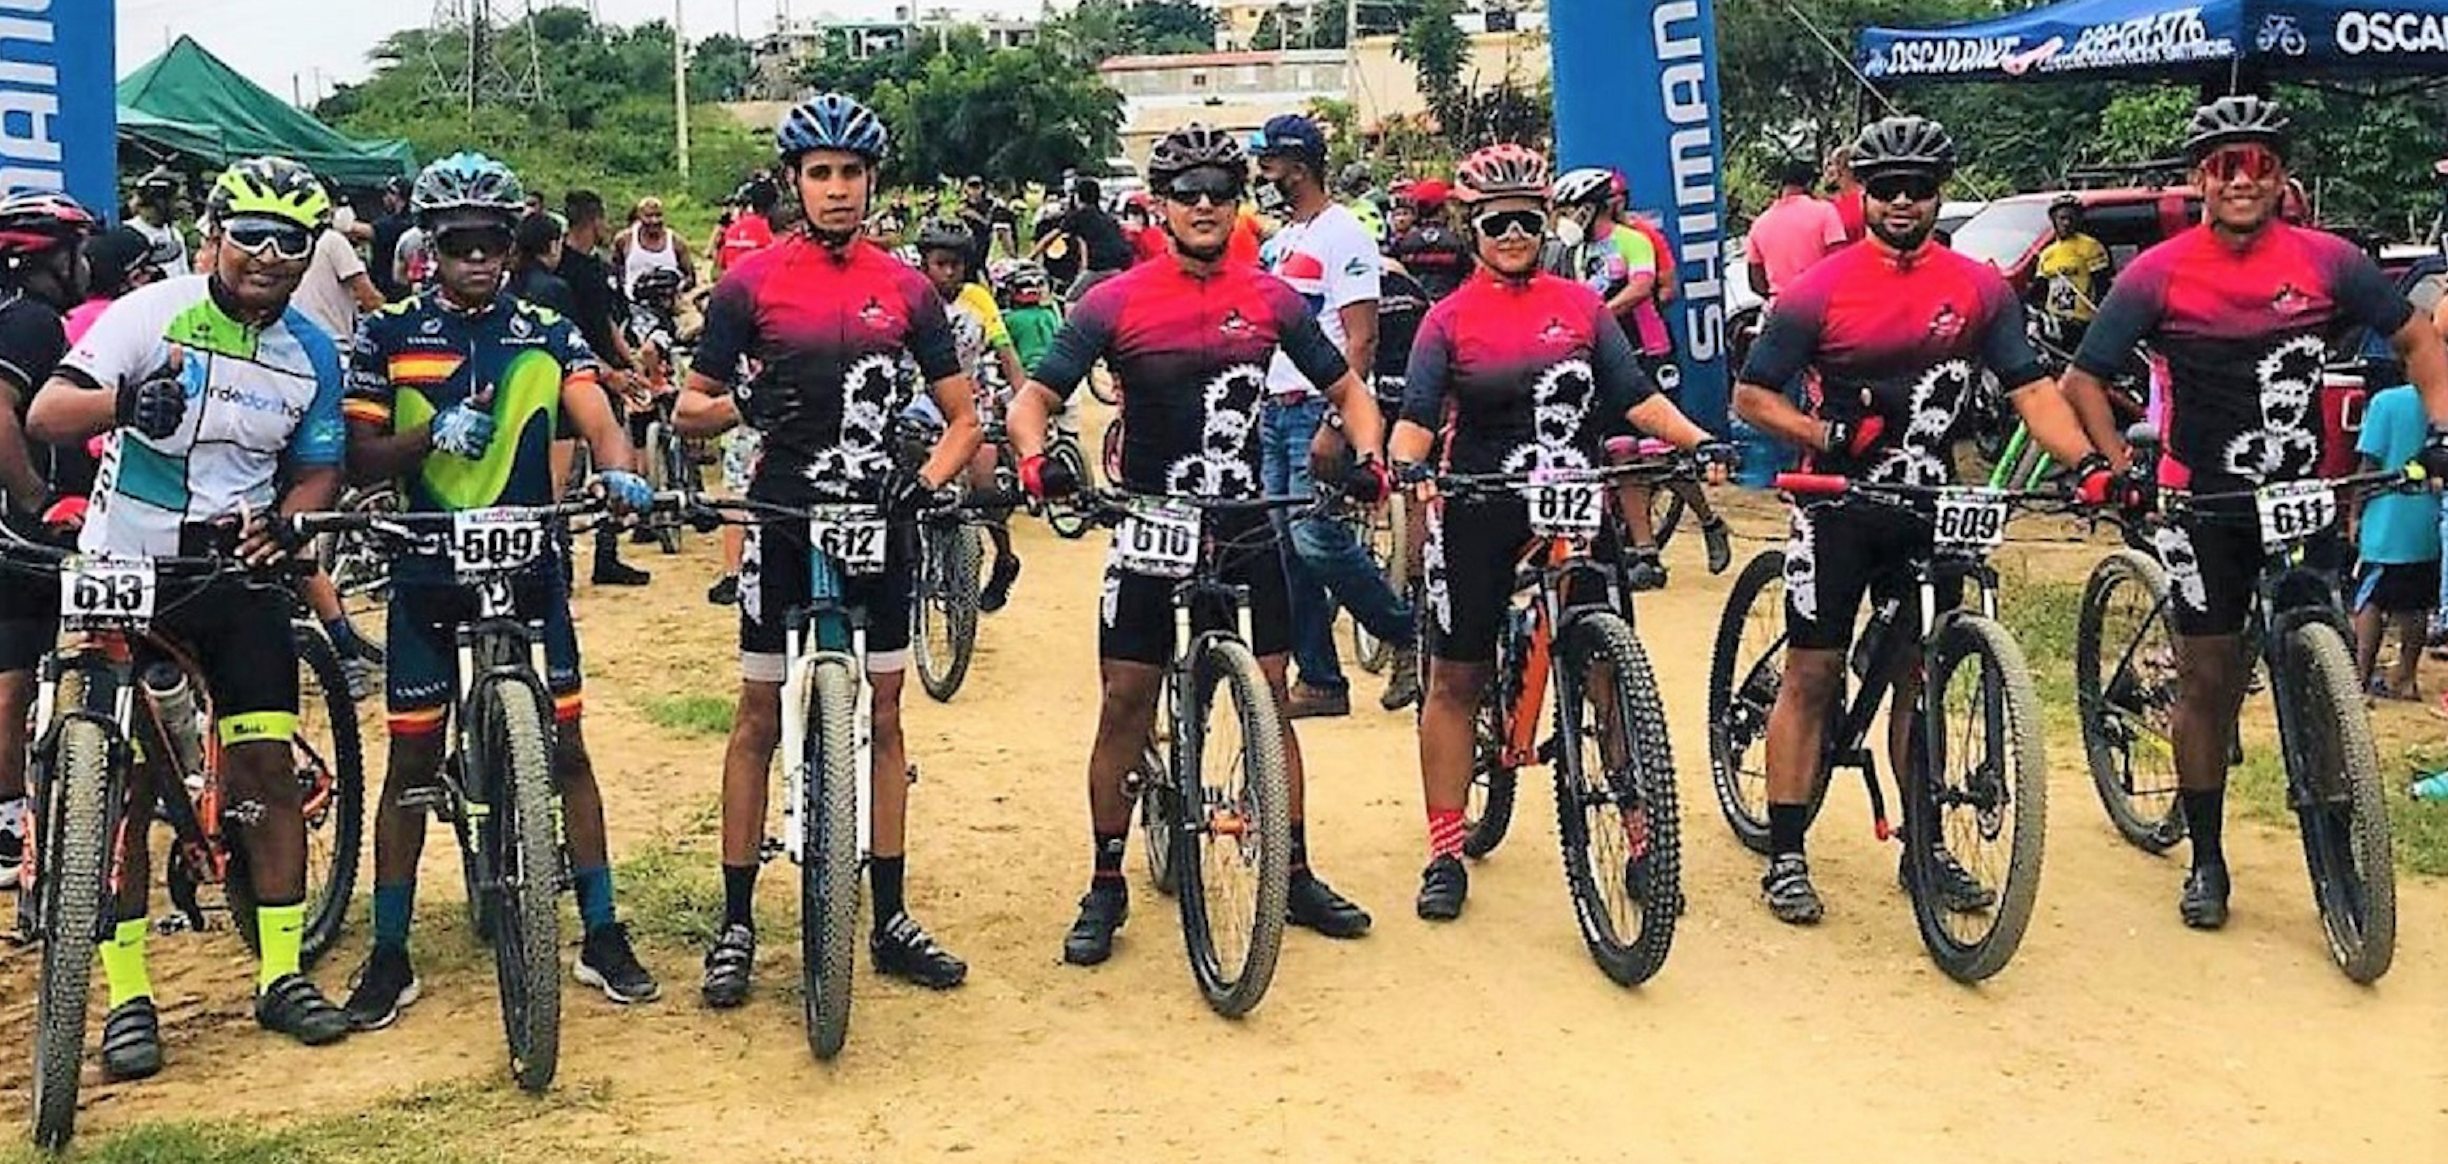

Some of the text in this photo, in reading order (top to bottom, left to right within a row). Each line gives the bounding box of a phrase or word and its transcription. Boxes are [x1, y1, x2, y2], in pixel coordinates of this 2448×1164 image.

[1539, 486, 1592, 520] 812
[2274, 498, 2323, 534] 611
[1133, 521, 1189, 556] 610
[1942, 507, 1999, 539] 609
[463, 528, 533, 564] 509
[821, 526, 874, 556] 612
[74, 574, 143, 611] 613
